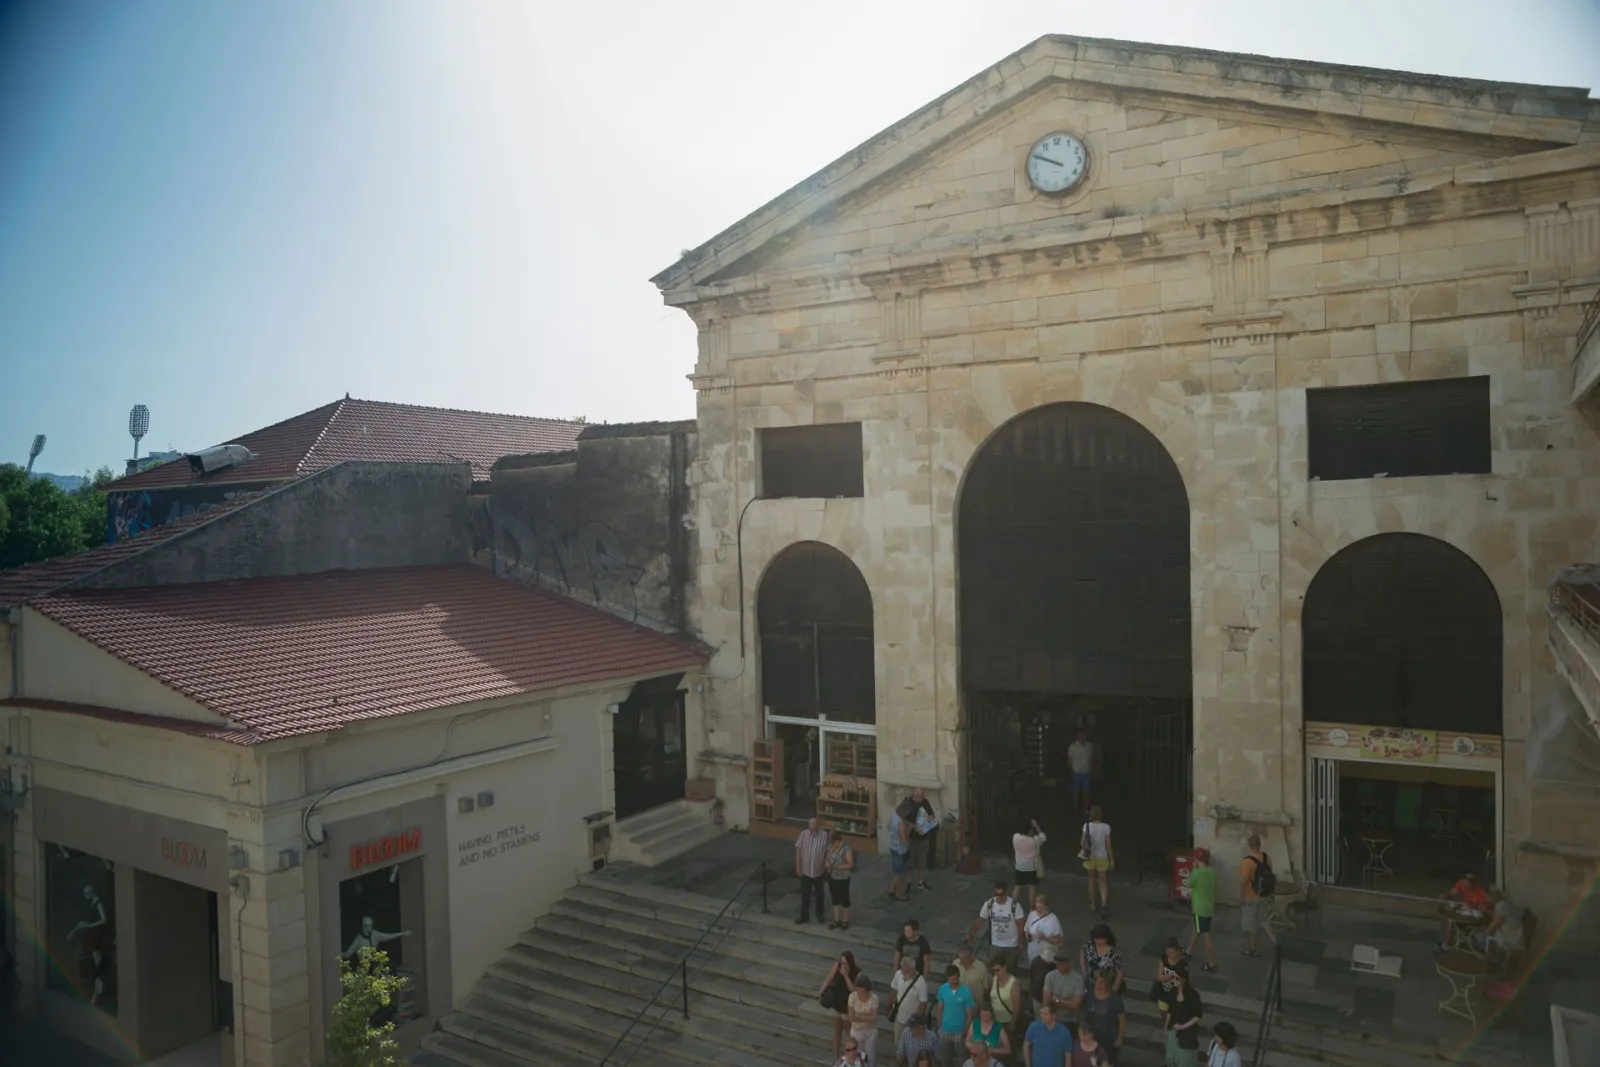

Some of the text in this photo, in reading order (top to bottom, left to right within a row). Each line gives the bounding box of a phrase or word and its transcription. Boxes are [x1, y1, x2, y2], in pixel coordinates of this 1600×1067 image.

[1053, 137, 1061, 145] 12
[1066, 139, 1071, 147] 1
[1074, 146, 1079, 154] 2
[1076, 156, 1082, 164] 3
[458, 824, 526, 853] HAVING PISTILS
[161, 837, 207, 870] BLOOM
[349, 827, 420, 869] BLOOM
[458, 831, 541, 868] AND NO STAMENS
